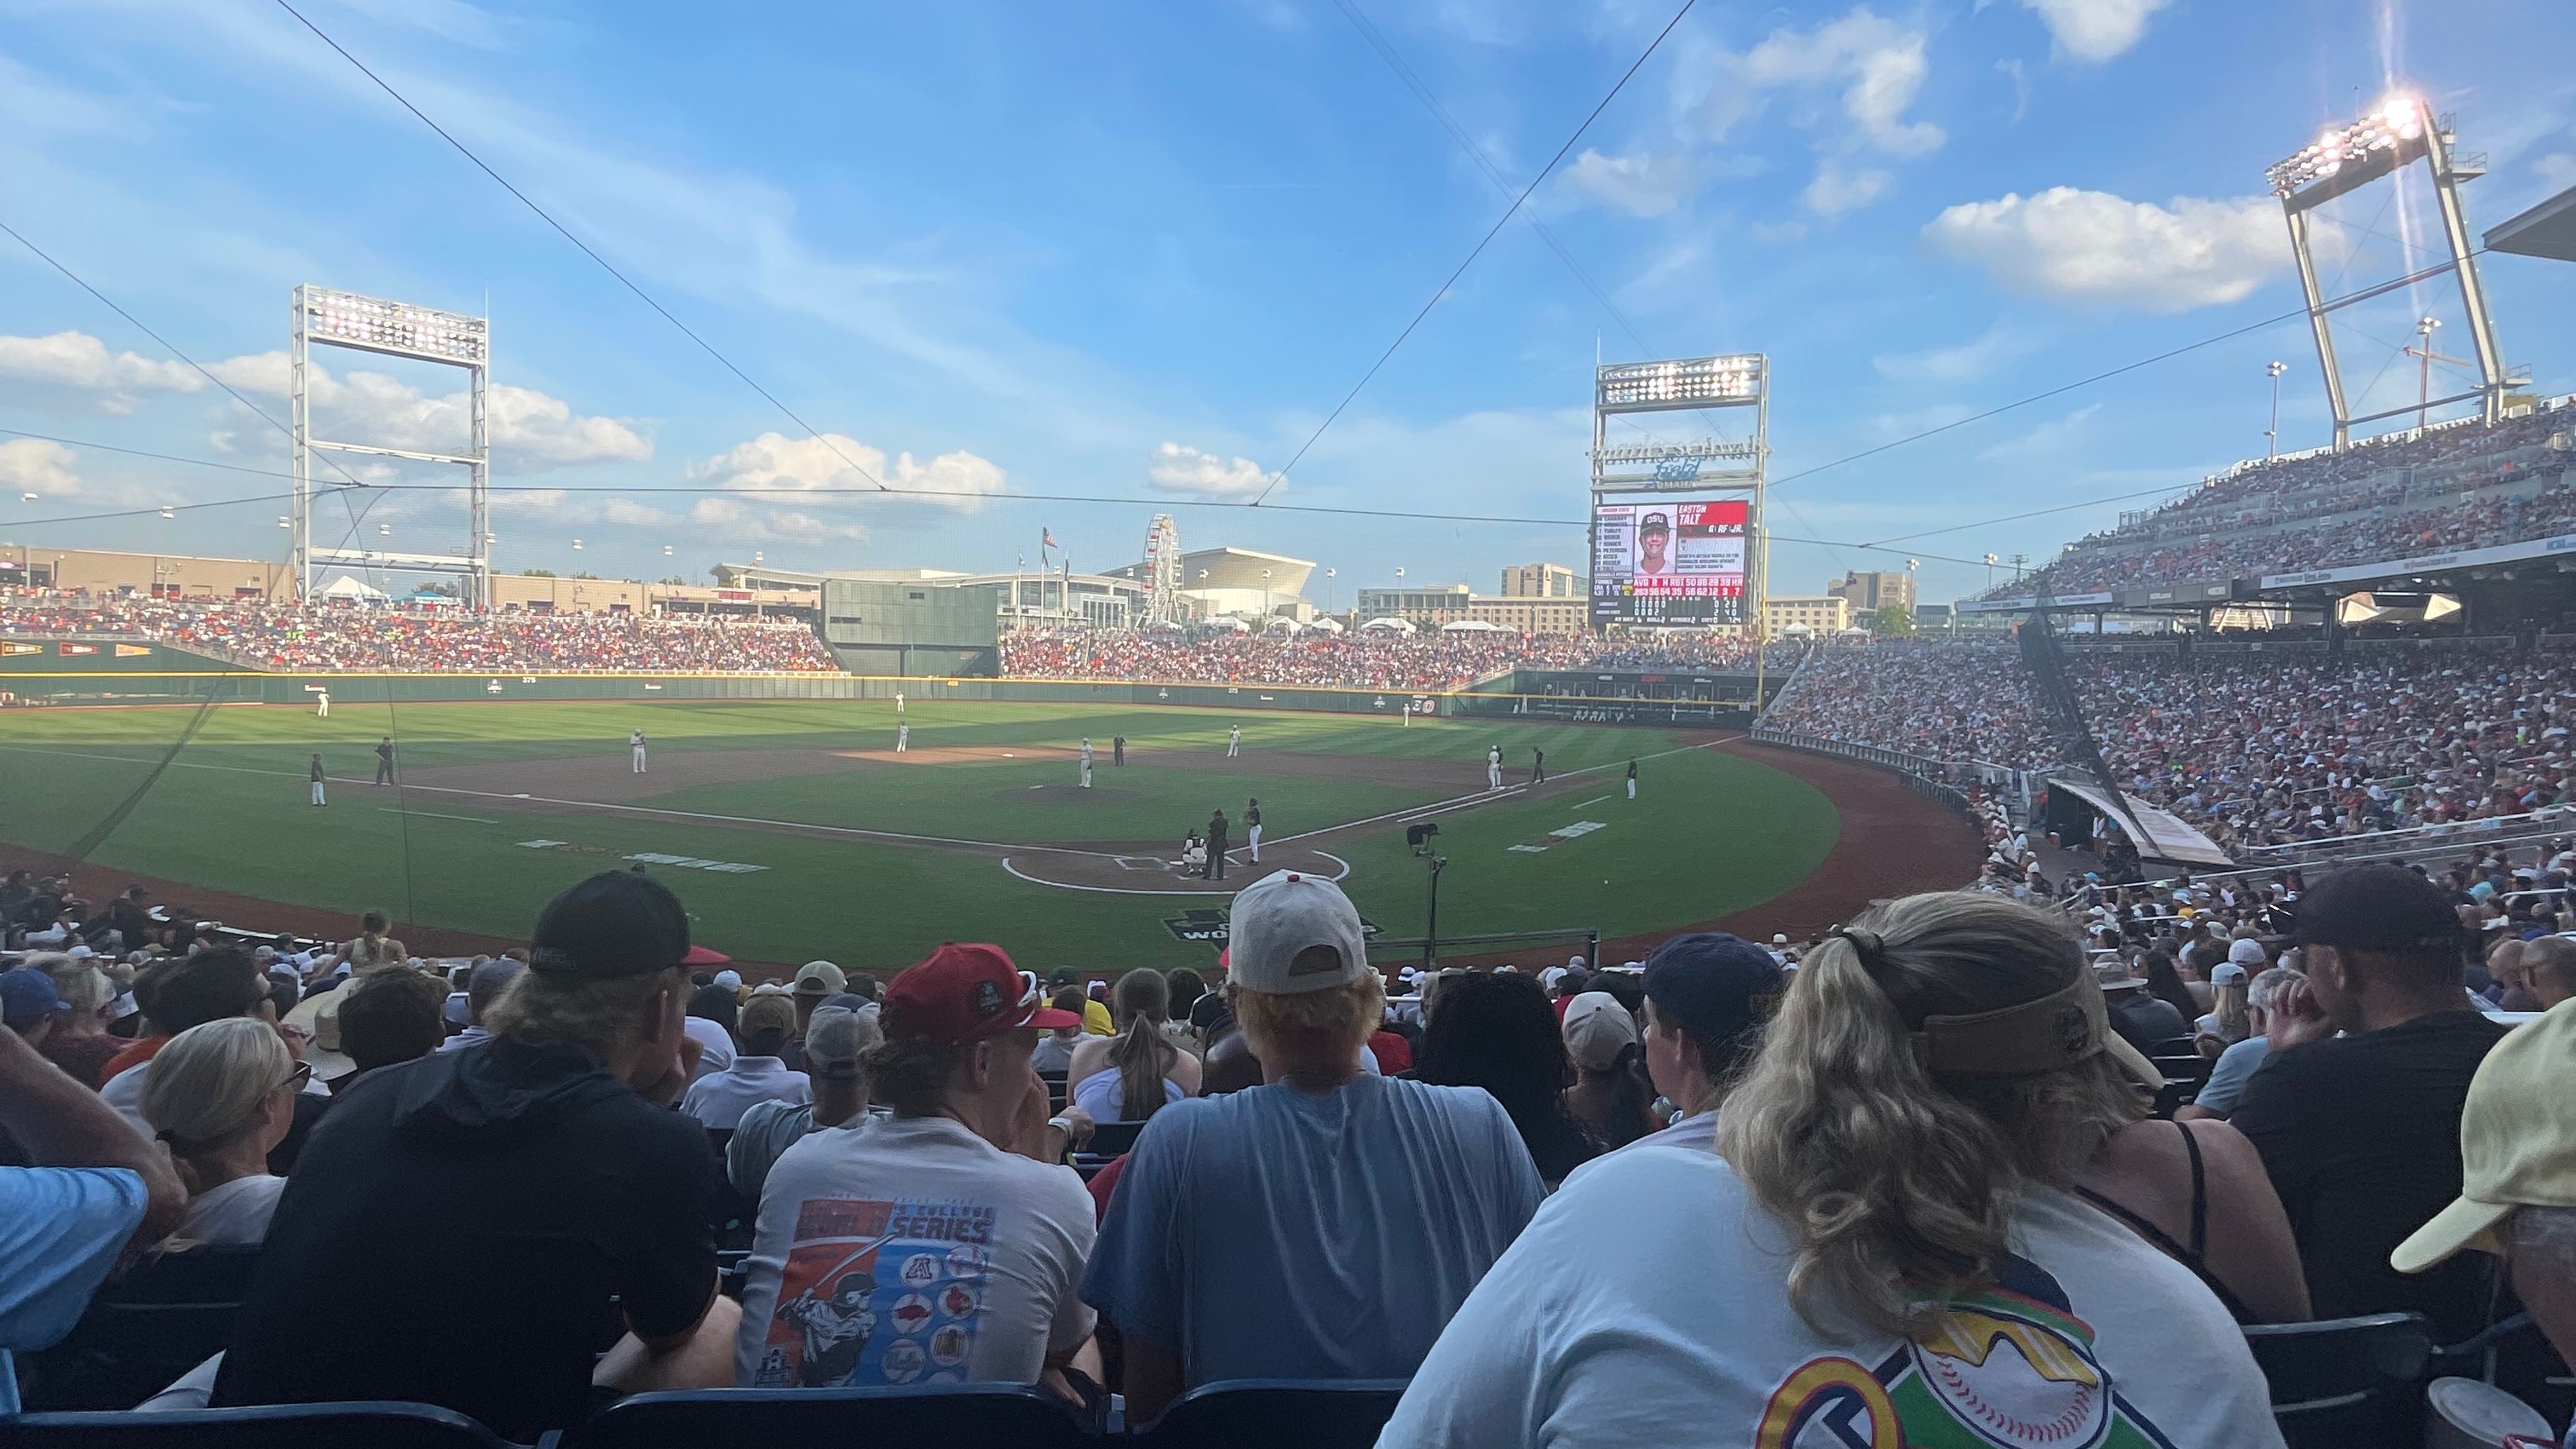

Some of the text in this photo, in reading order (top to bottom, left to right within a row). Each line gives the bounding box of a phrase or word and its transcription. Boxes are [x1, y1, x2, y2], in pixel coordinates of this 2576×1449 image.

[1678, 504, 1707, 513] EASTON
[1647, 515, 1664, 524] OSU
[1679, 514, 1702, 525] TALT
[893, 1216, 993, 1244] SERIES
